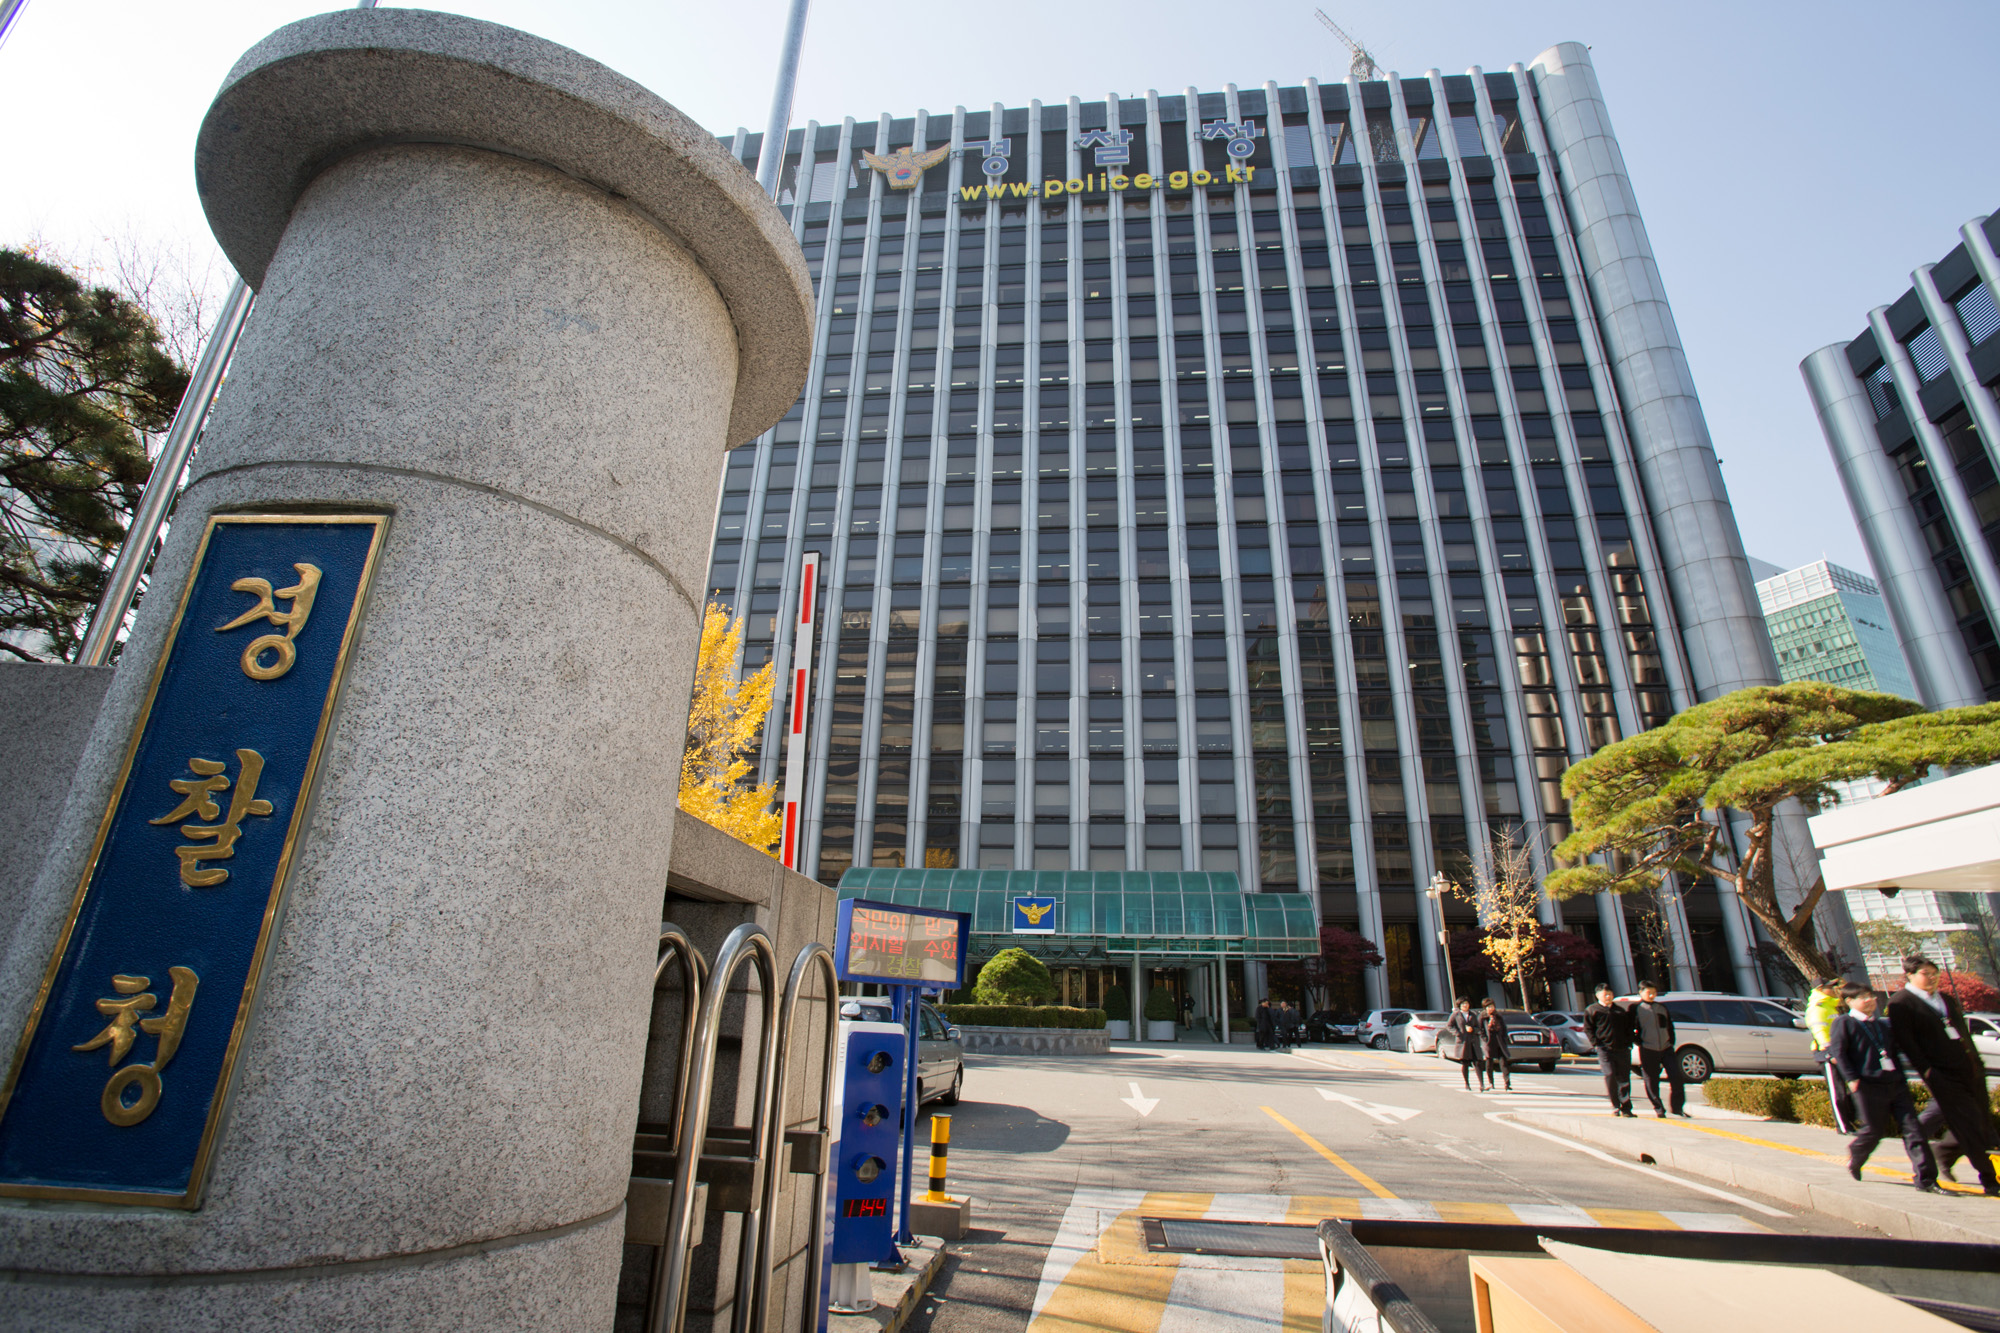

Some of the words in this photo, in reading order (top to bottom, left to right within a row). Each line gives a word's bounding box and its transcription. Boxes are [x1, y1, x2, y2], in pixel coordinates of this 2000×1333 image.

[962, 119, 1256, 177] 경찰청
[960, 164, 1256, 201] www.police.go.kr
[71, 562, 323, 1126] 경찰청
[852, 907, 906, 933] 국민이
[925, 917, 958, 937] 믿고
[850, 932, 907, 955] 의지할
[887, 955, 923, 977] 경찰
[848, 1199, 887, 1218] 11:44
